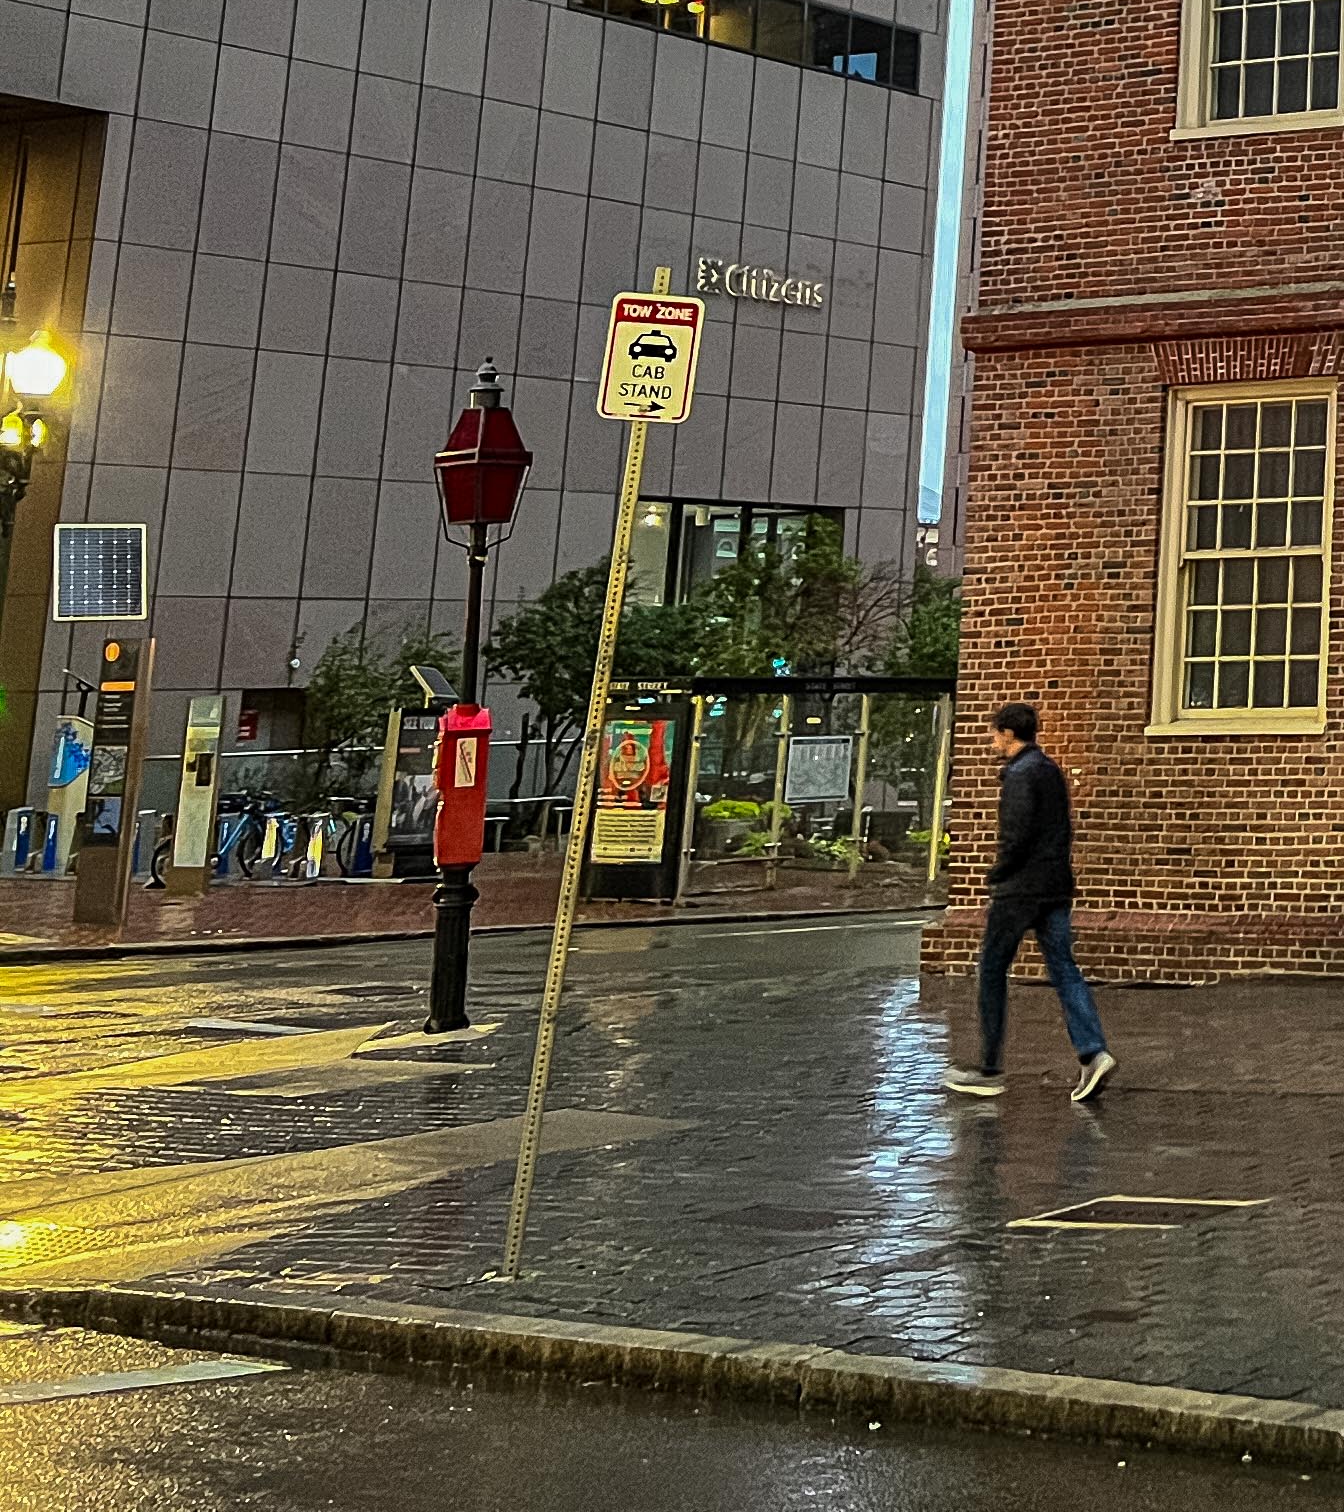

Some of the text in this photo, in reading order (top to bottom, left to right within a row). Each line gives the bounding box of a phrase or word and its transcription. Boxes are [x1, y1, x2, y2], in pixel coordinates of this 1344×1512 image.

[725, 263, 824, 307] Citizens
[622, 303, 694, 320] TOW ZONE
[632, 364, 665, 380] CAB
[618, 383, 672, 400] STAND
